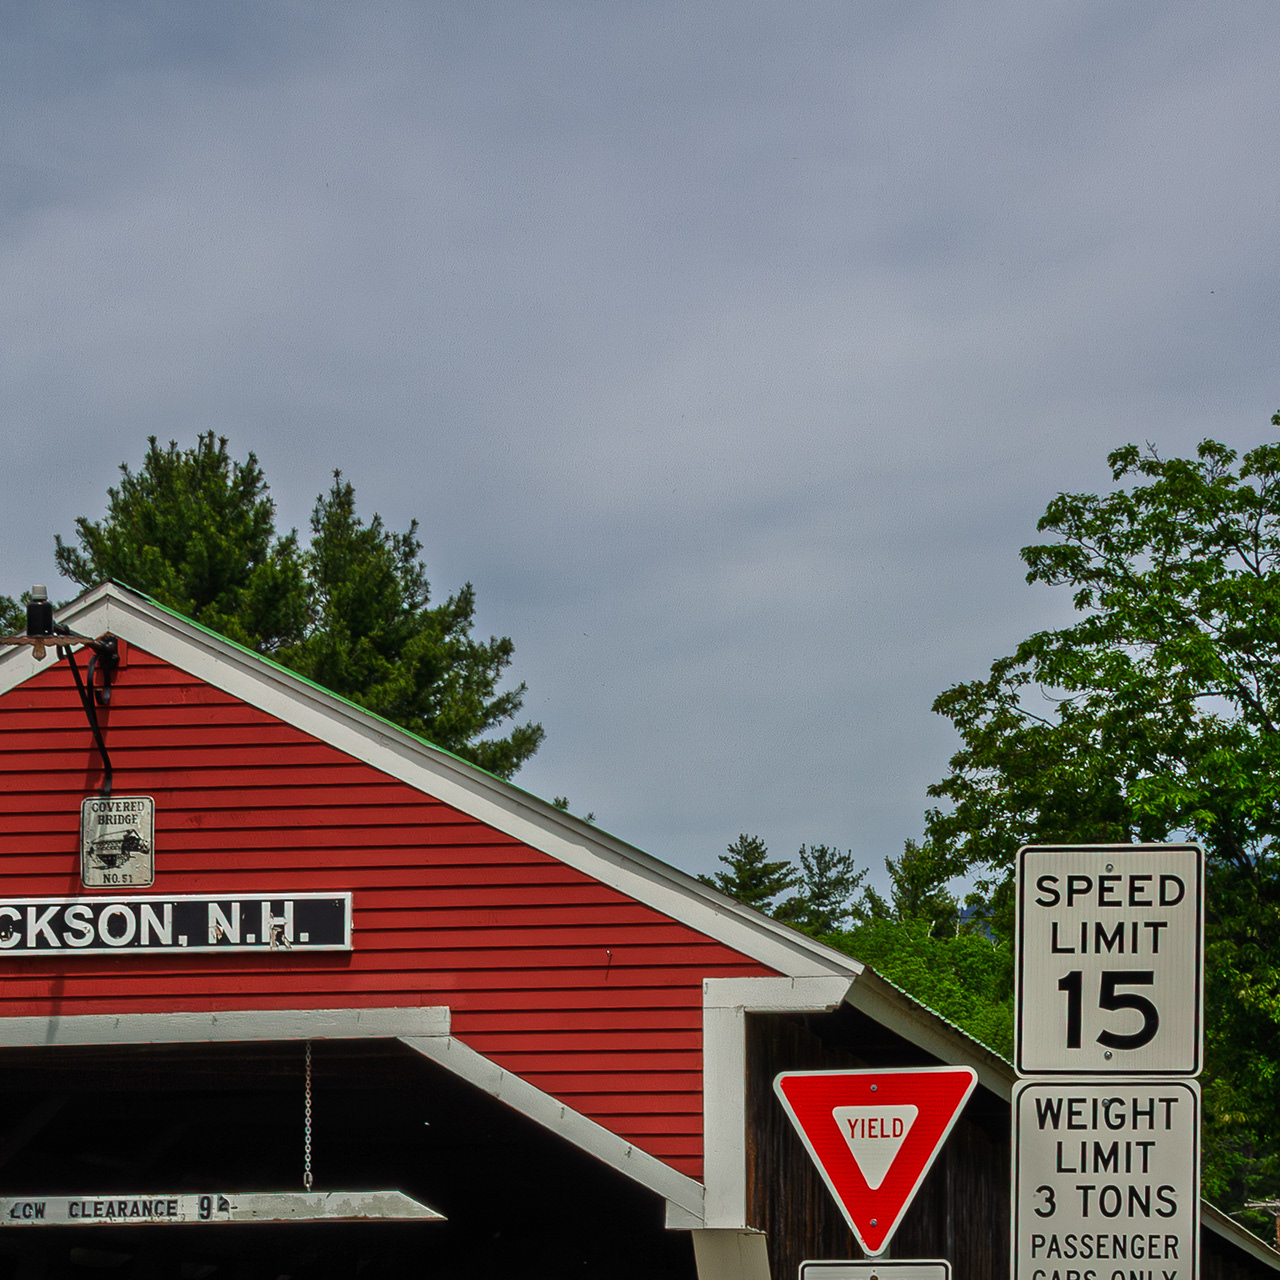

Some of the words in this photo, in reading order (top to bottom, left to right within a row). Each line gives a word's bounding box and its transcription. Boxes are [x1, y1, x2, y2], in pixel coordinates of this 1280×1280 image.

[91, 801, 145, 813] COVERED
[97, 814, 138, 825] BRIDGE
[1035, 874, 1186, 907] SPEED
[207, 900, 310, 948] N.H.
[1051, 921, 1168, 954] LIMIT
[1058, 970, 1160, 1051] 15
[847, 1118, 904, 1139] YIELD
[1035, 1097, 1179, 1131] WEIGHT
[1056, 1141, 1156, 1174] LIMIT
[70, 1199, 178, 1218] CLEARANCE
[1034, 1185, 1057, 1218] 3
[1075, 1184, 1177, 1218] TONS
[1031, 1233, 1179, 1259] PASSENGER
